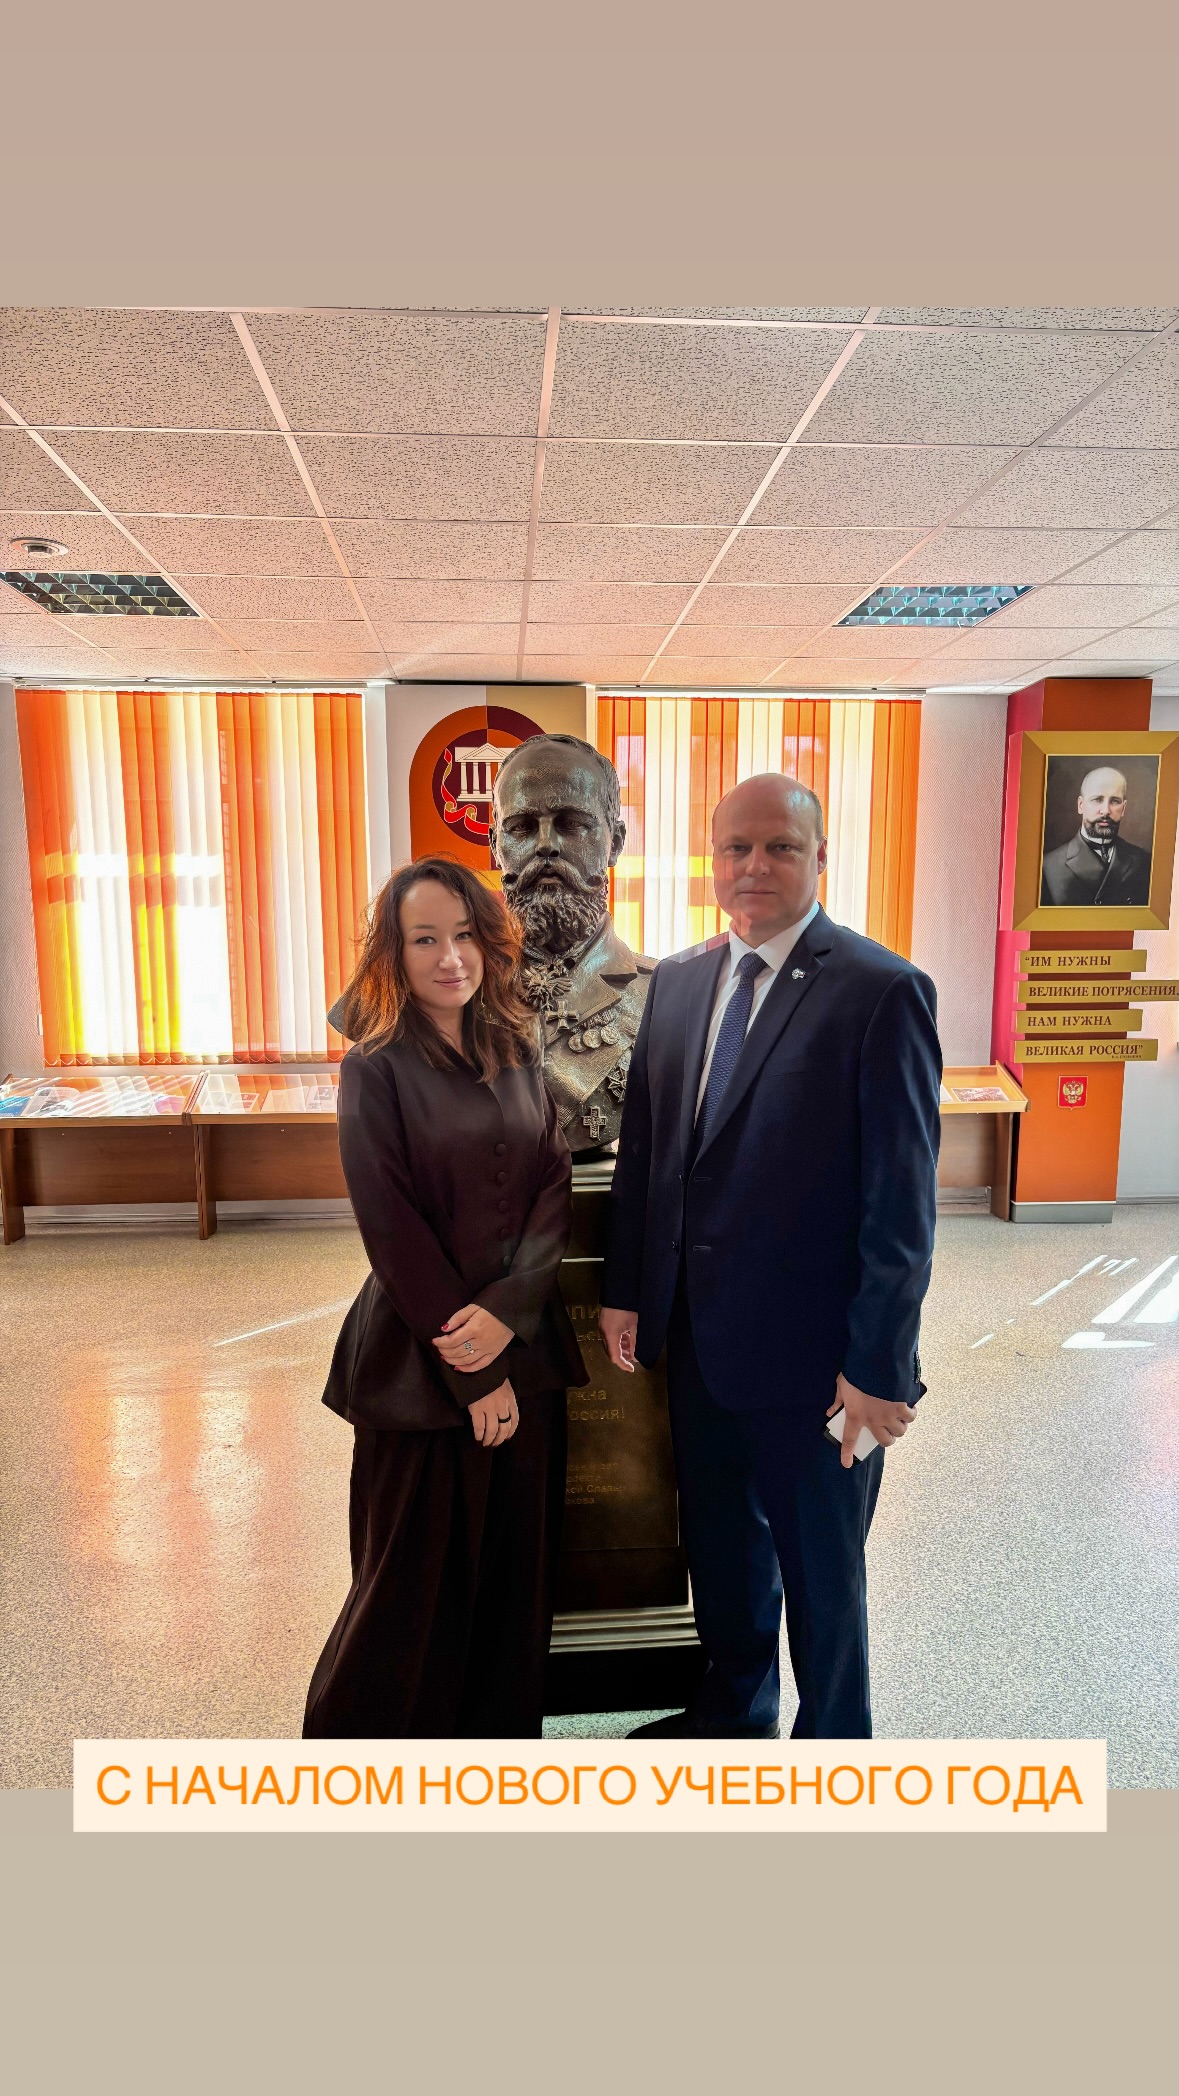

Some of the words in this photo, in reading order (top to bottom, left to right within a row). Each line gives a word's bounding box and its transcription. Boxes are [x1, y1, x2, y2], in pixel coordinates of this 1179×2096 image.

[1057, 956, 1112, 967] НУЖНЫ
[1028, 986, 1089, 997] ВЕЛИКИЕ
[1027, 1016, 1057, 1027] НАМ
[1062, 1015, 1112, 1026] НУЖНА
[1025, 1046, 1084, 1056] ВЕЛИКАЯ
